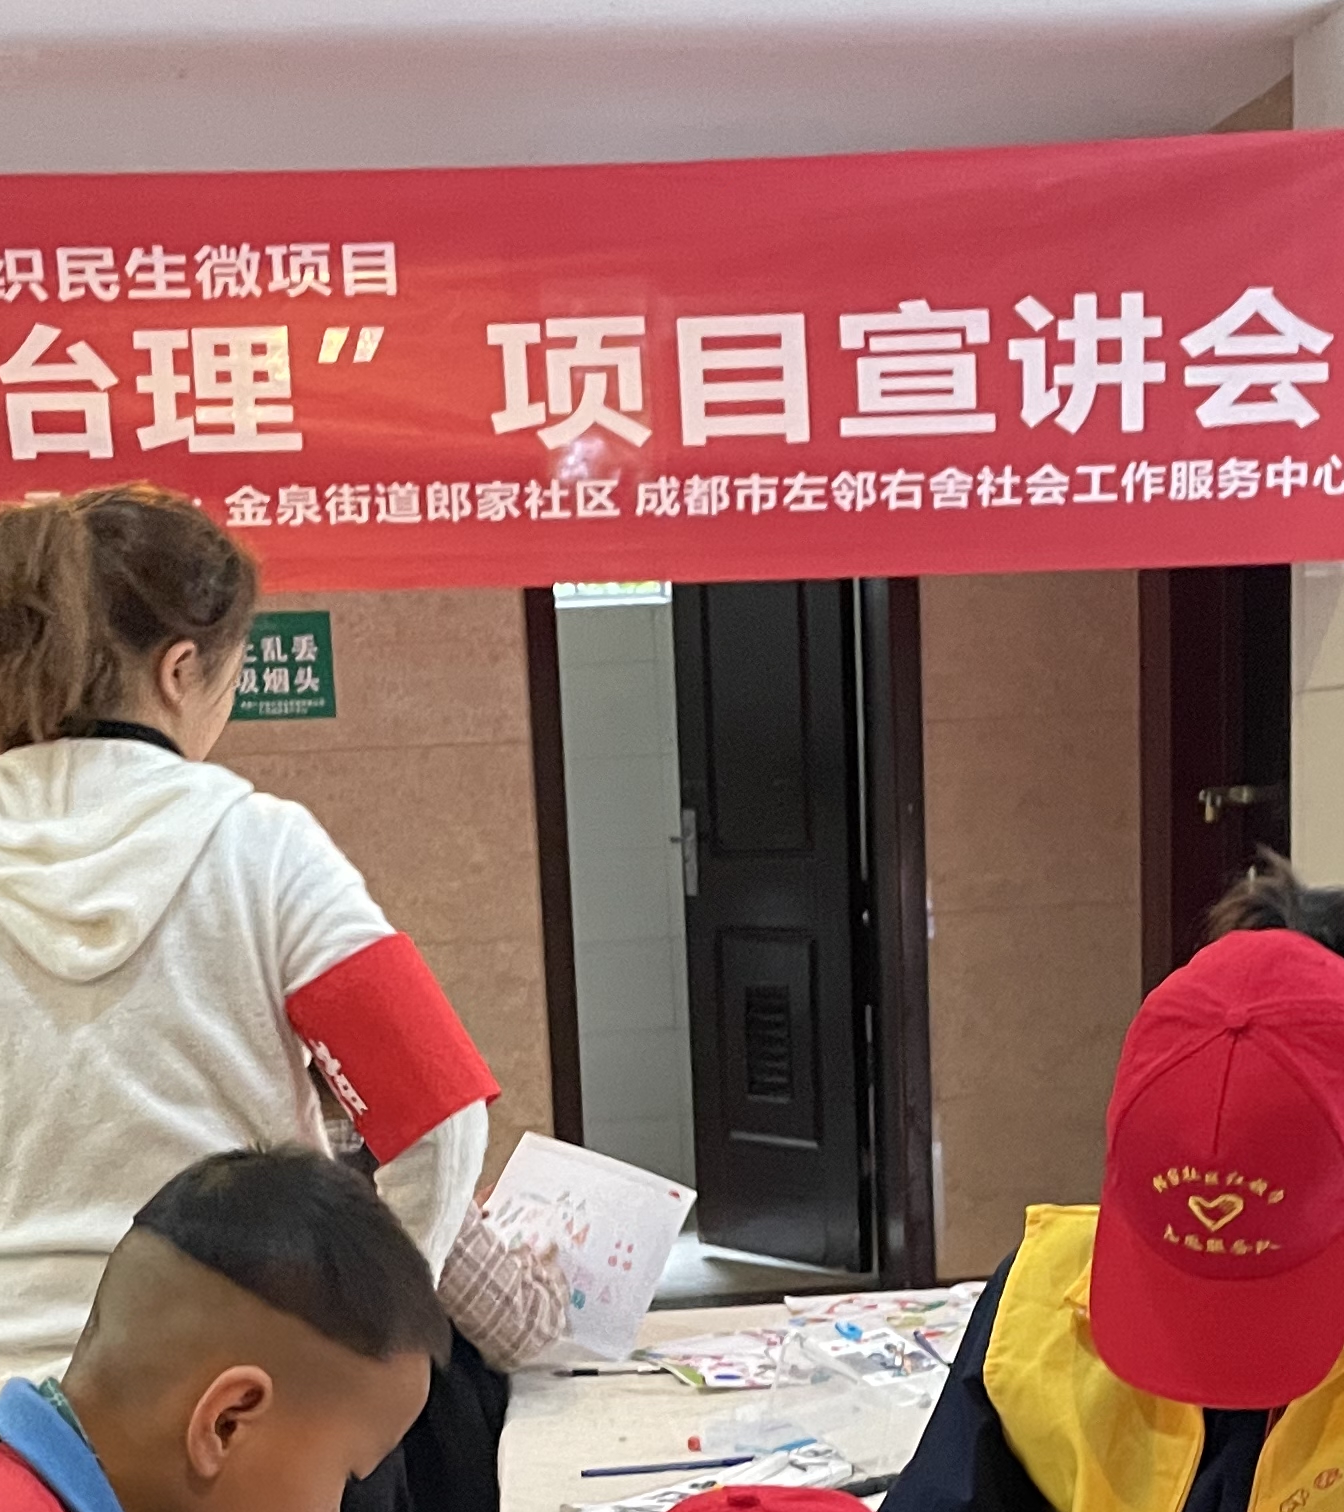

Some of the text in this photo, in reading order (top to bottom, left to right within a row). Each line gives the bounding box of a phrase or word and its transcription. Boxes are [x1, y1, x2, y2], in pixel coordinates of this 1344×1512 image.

[486, 286, 1335, 449] 项目宣讲会
[225, 479, 621, 527] 金泉街道郎家社区
